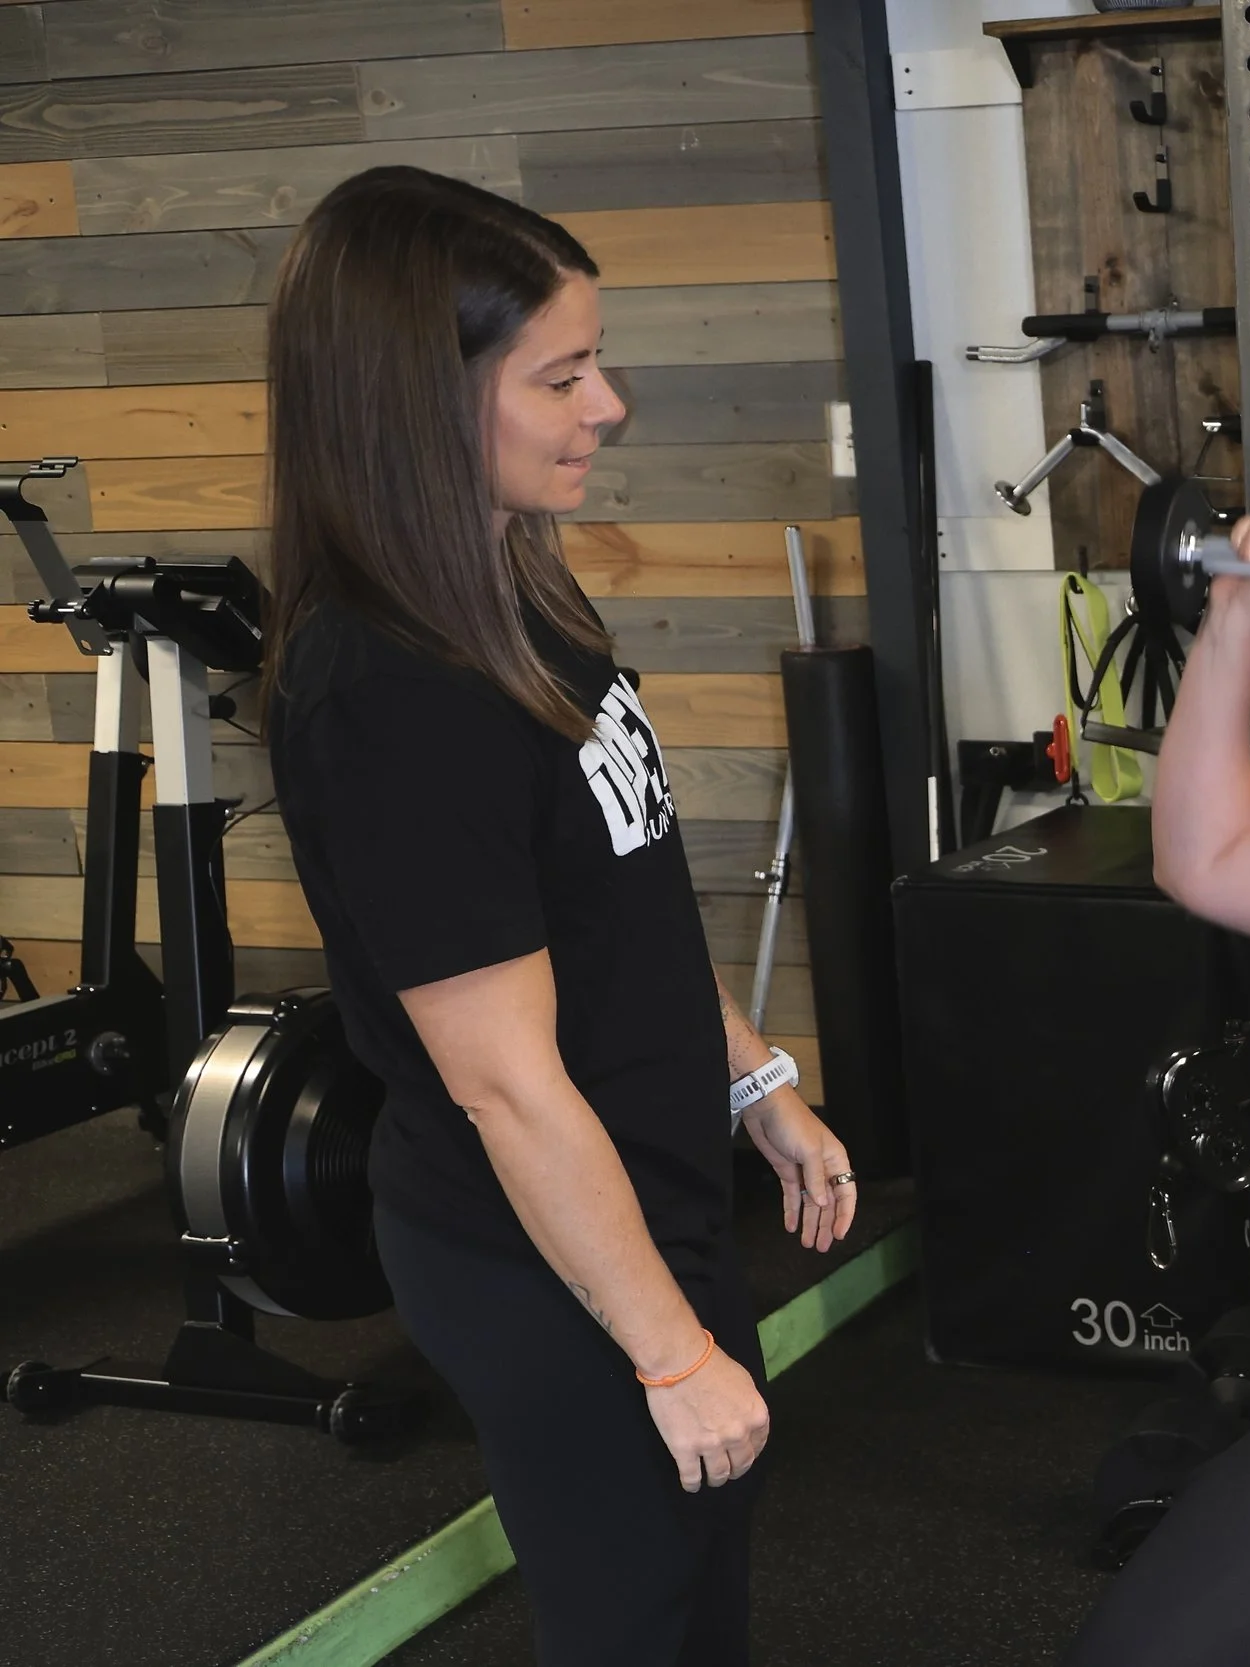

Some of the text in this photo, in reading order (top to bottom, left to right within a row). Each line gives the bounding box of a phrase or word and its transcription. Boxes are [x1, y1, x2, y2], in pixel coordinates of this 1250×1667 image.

[63, 1028, 79, 1046] 2
[1070, 1297, 1190, 1352] 30 inch
